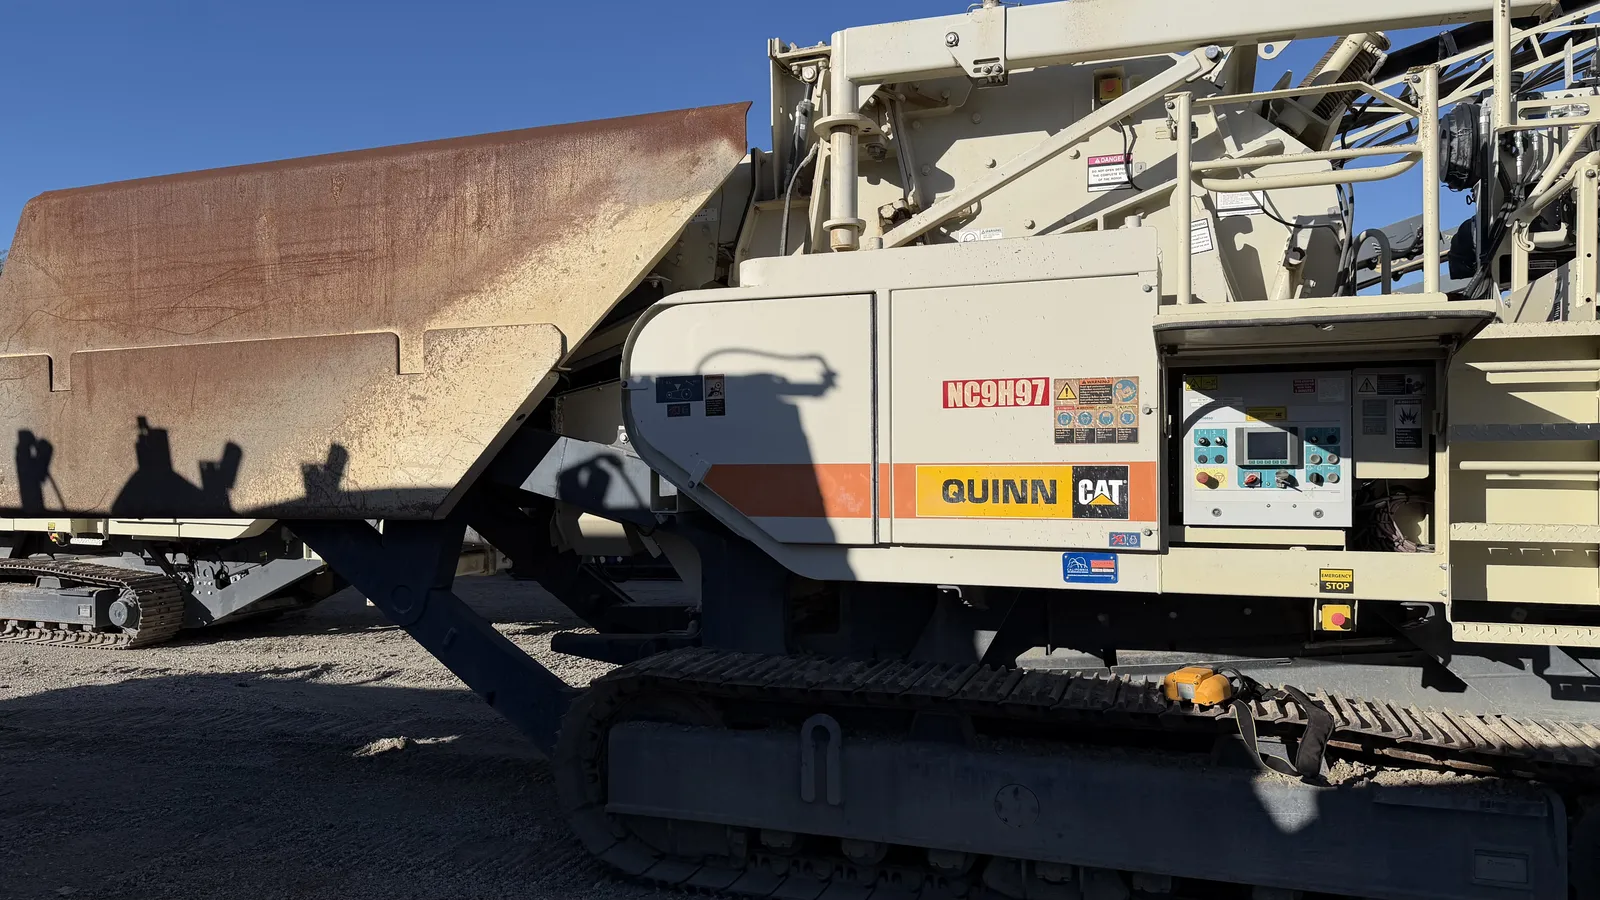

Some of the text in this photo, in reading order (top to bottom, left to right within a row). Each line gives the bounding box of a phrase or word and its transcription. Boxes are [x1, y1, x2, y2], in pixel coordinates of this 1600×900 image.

[947, 379, 1046, 408] NC9H97
[942, 478, 1123, 506] QUINN CAT
[1326, 582, 1350, 590] STOP
